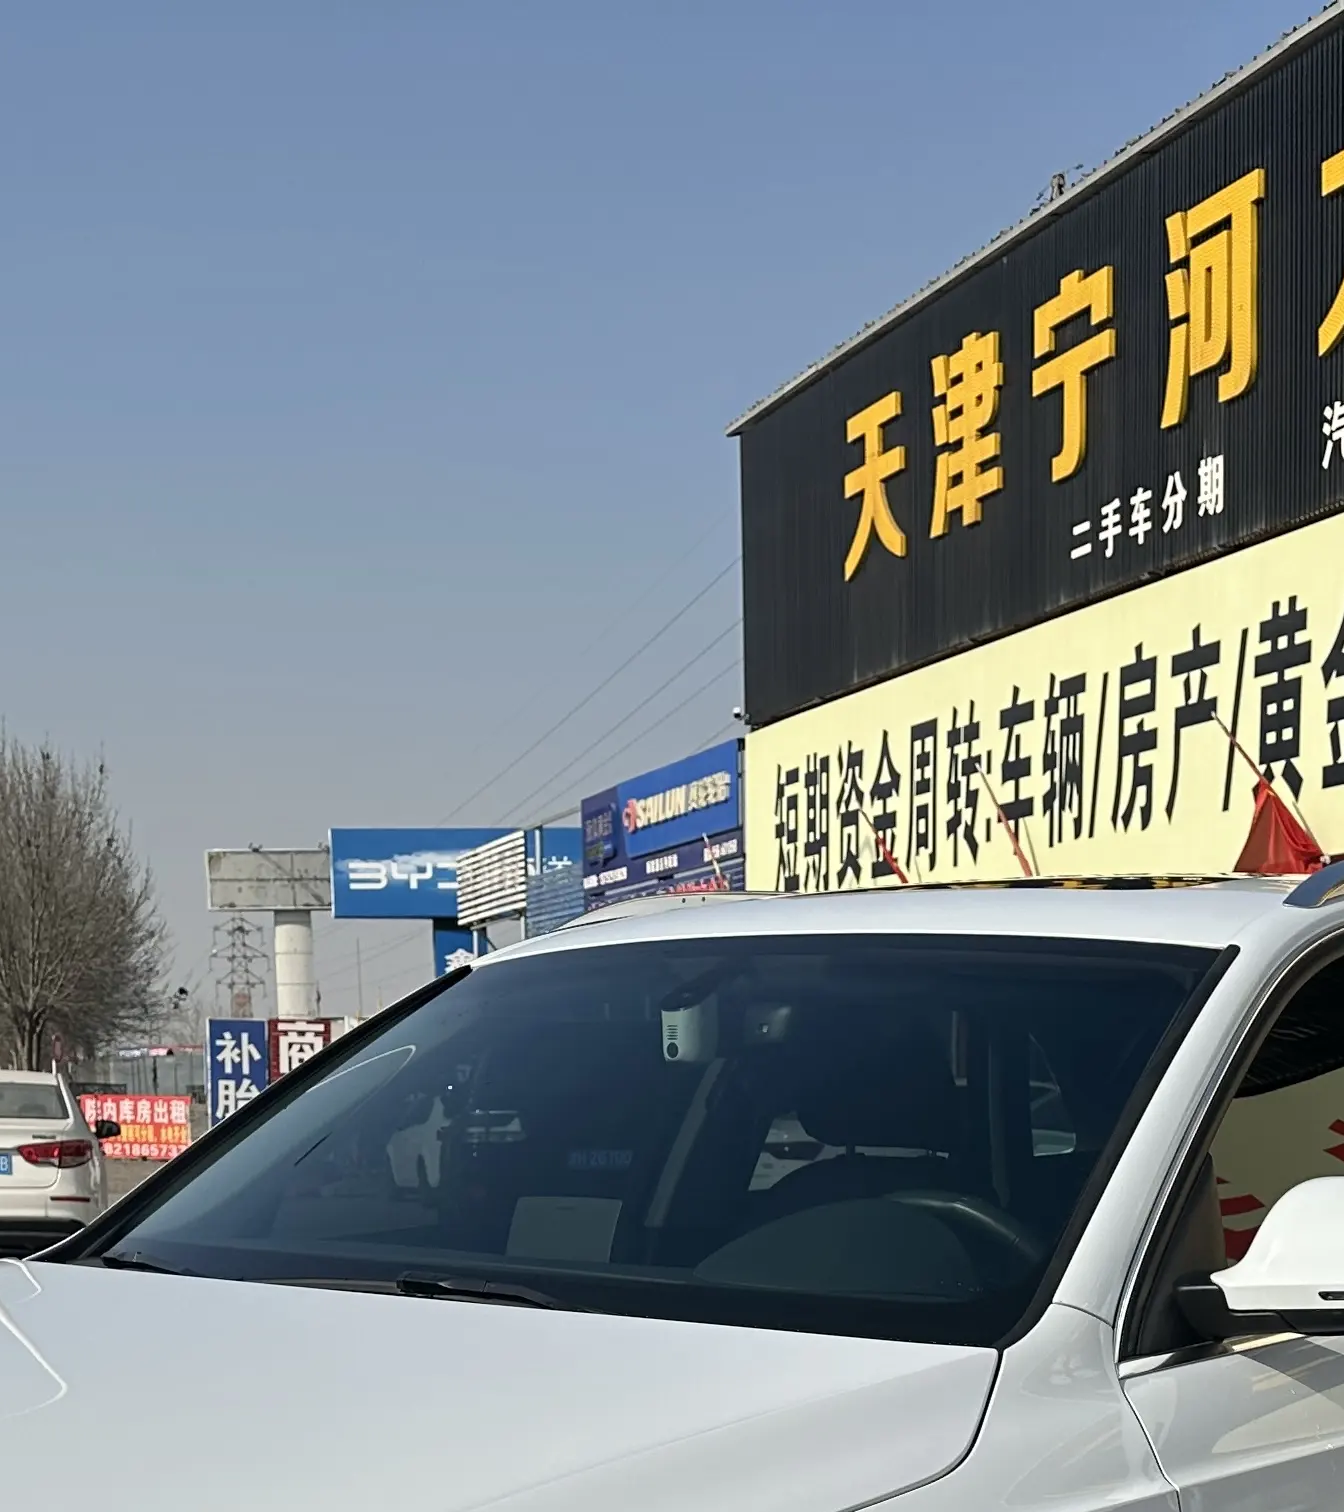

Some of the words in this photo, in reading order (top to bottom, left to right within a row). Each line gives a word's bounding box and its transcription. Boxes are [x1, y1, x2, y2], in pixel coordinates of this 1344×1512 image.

[1070, 454, 1224, 560] 二手车分期
[636, 784, 687, 829] SAILUN
[215, 1031, 262, 1119] 补胎
